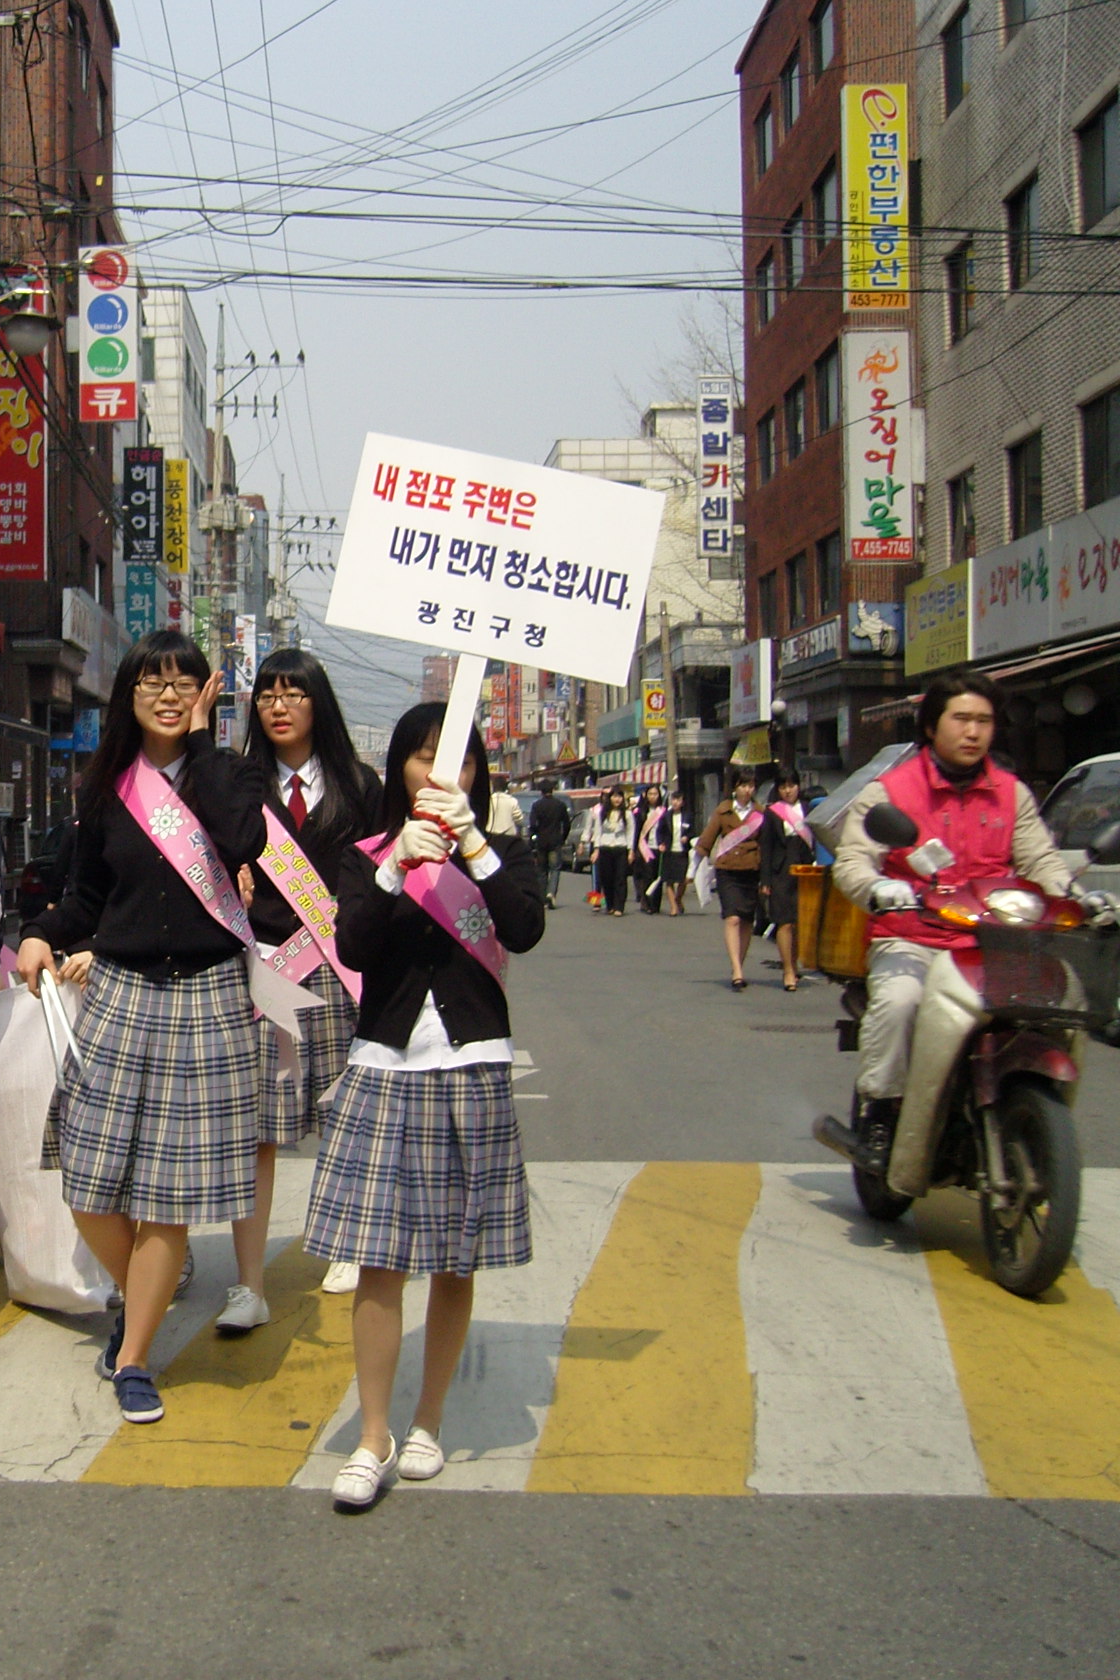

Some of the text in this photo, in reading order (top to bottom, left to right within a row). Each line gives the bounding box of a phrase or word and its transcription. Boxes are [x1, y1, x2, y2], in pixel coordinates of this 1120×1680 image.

[850, 291, 906, 307] 453-7771
[88, 389, 127, 417] 큐
[373, 463, 537, 530] 내 점포 주변은
[702, 398, 731, 553] 종합카센타
[165, 480, 185, 568] 풍천장어
[389, 526, 630, 610] 내가 먼저 청소합시다.
